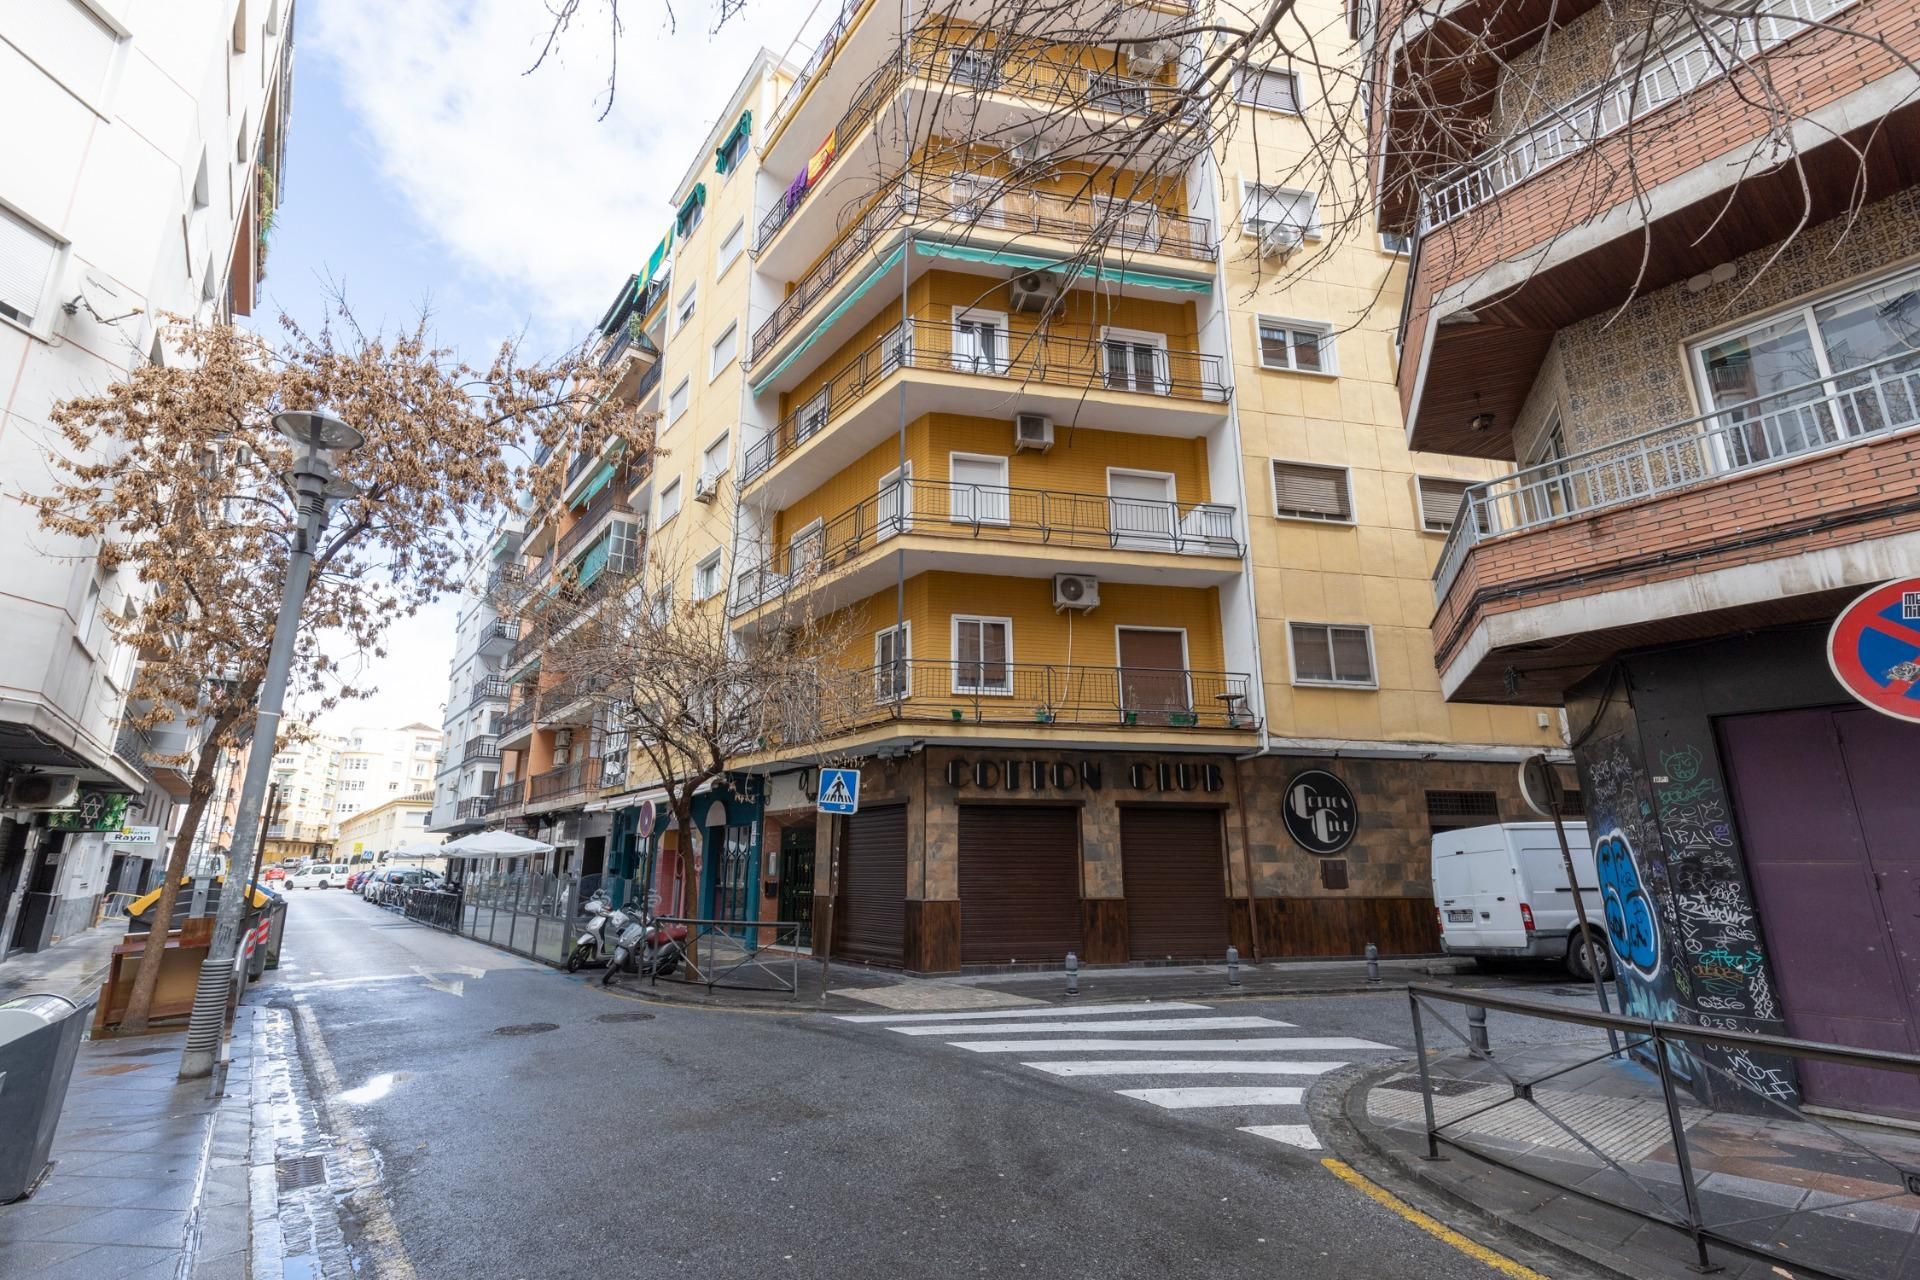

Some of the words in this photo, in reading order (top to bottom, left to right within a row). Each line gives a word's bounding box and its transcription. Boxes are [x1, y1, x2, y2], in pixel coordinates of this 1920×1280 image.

[945, 759, 1102, 790] COTTON
[1130, 763, 1224, 791] CLUB
[1290, 784, 1348, 819] COTTON
[1312, 808, 1349, 843] CLUB
